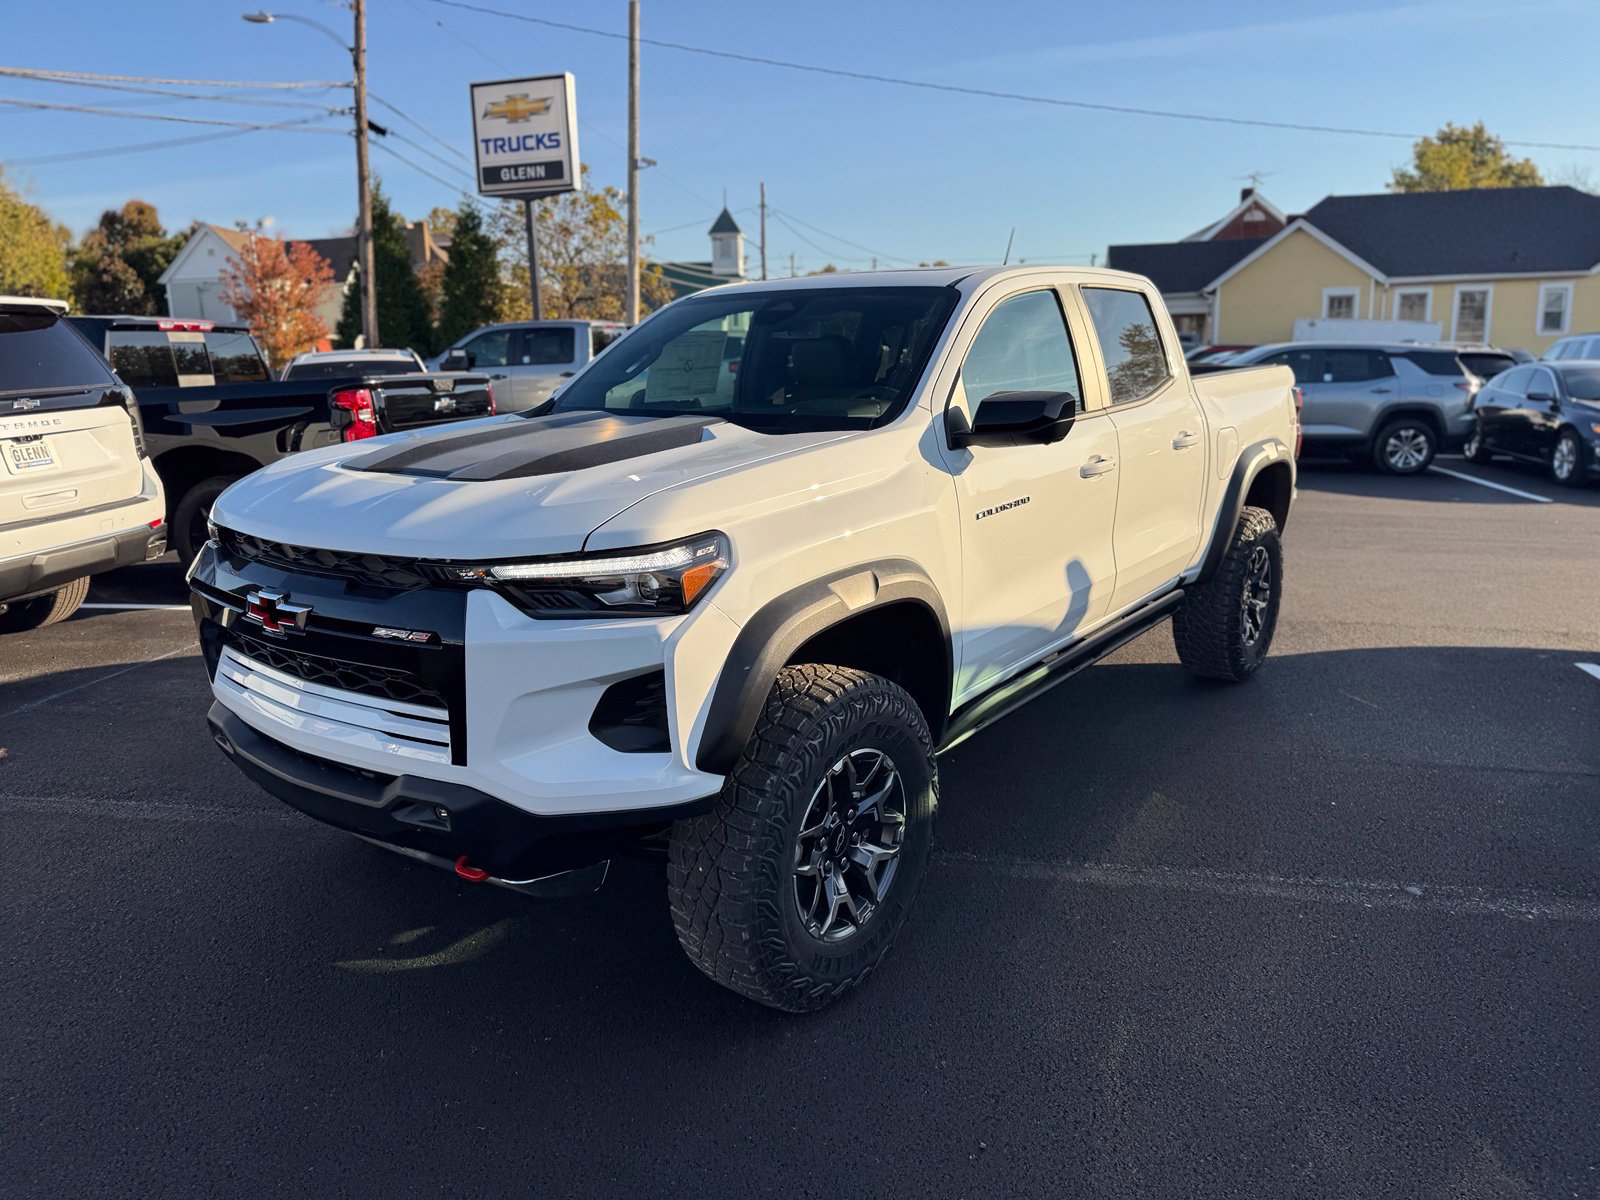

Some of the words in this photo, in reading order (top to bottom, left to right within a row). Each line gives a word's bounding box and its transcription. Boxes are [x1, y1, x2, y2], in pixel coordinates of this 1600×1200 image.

[481, 132, 561, 154] TRUCKS
[500, 164, 546, 181] GLENN
[0, 418, 62, 431] TAHOE
[12, 445, 50, 462] GLENN
[975, 496, 1031, 521] COLORADO
